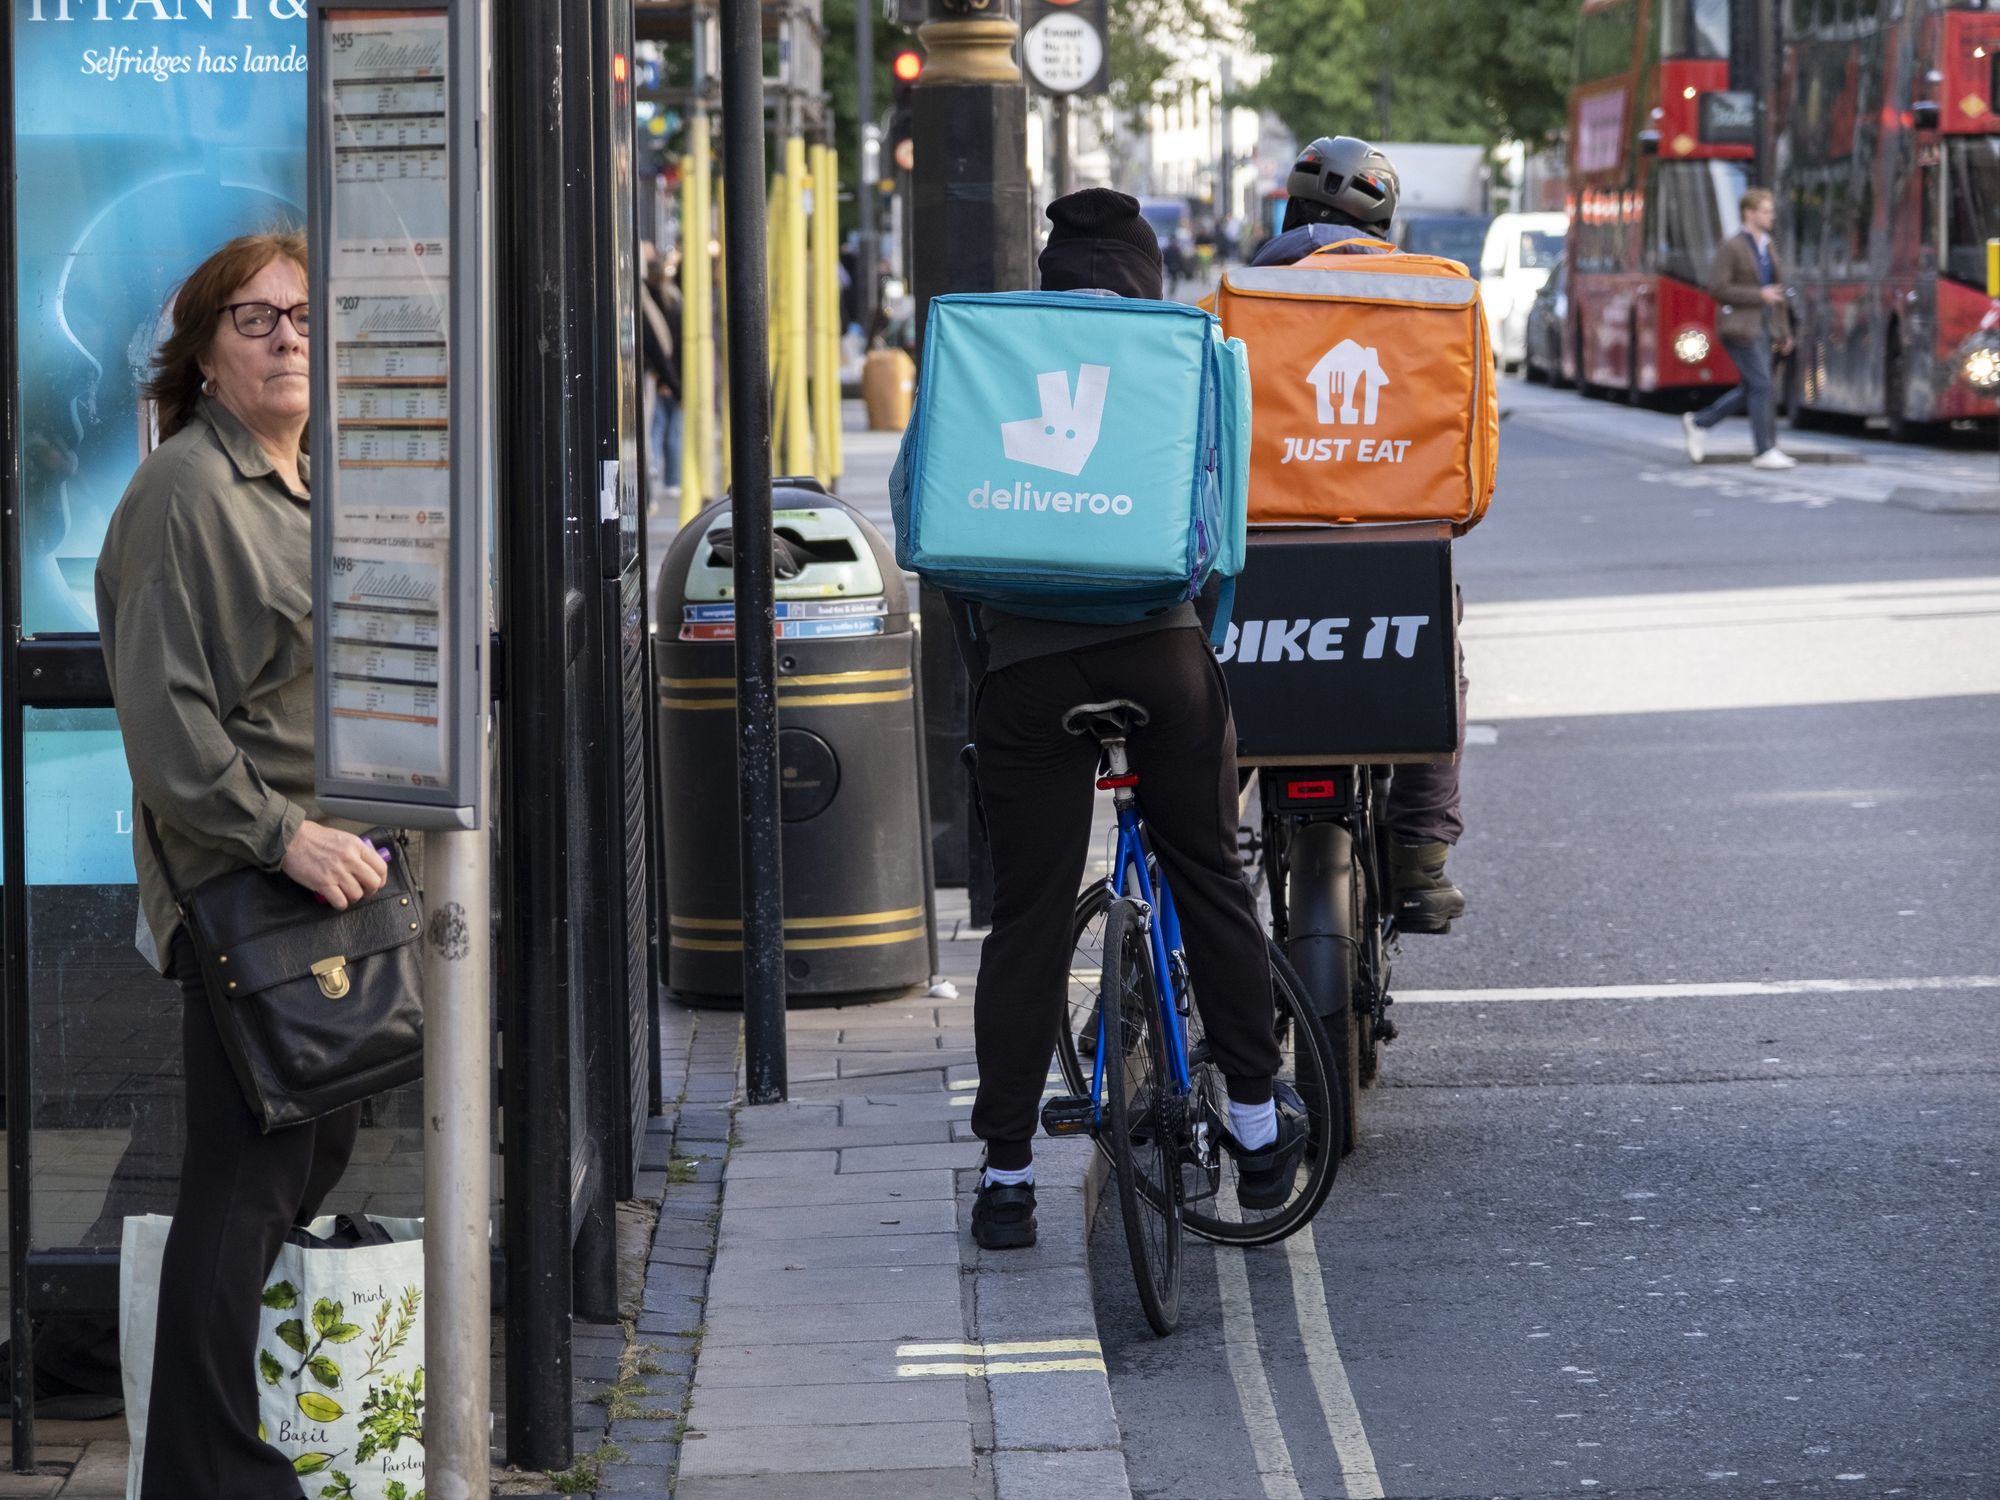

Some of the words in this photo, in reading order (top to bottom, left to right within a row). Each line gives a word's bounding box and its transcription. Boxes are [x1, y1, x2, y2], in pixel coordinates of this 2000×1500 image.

[333, 32, 354, 48] N55
[81, 46, 192, 81] Selfridges
[197, 45, 238, 72] has
[243, 44, 308, 72] lande
[335, 296, 361, 310] N207
[1281, 438, 1351, 464] JUST
[1357, 439, 1412, 463] EAT
[968, 480, 1133, 515] deliveroo
[333, 556, 353, 572] N98
[1363, 615, 1430, 659] IT
[280, 1420, 329, 1444] Basil
[383, 1455, 425, 1480] Parsley
